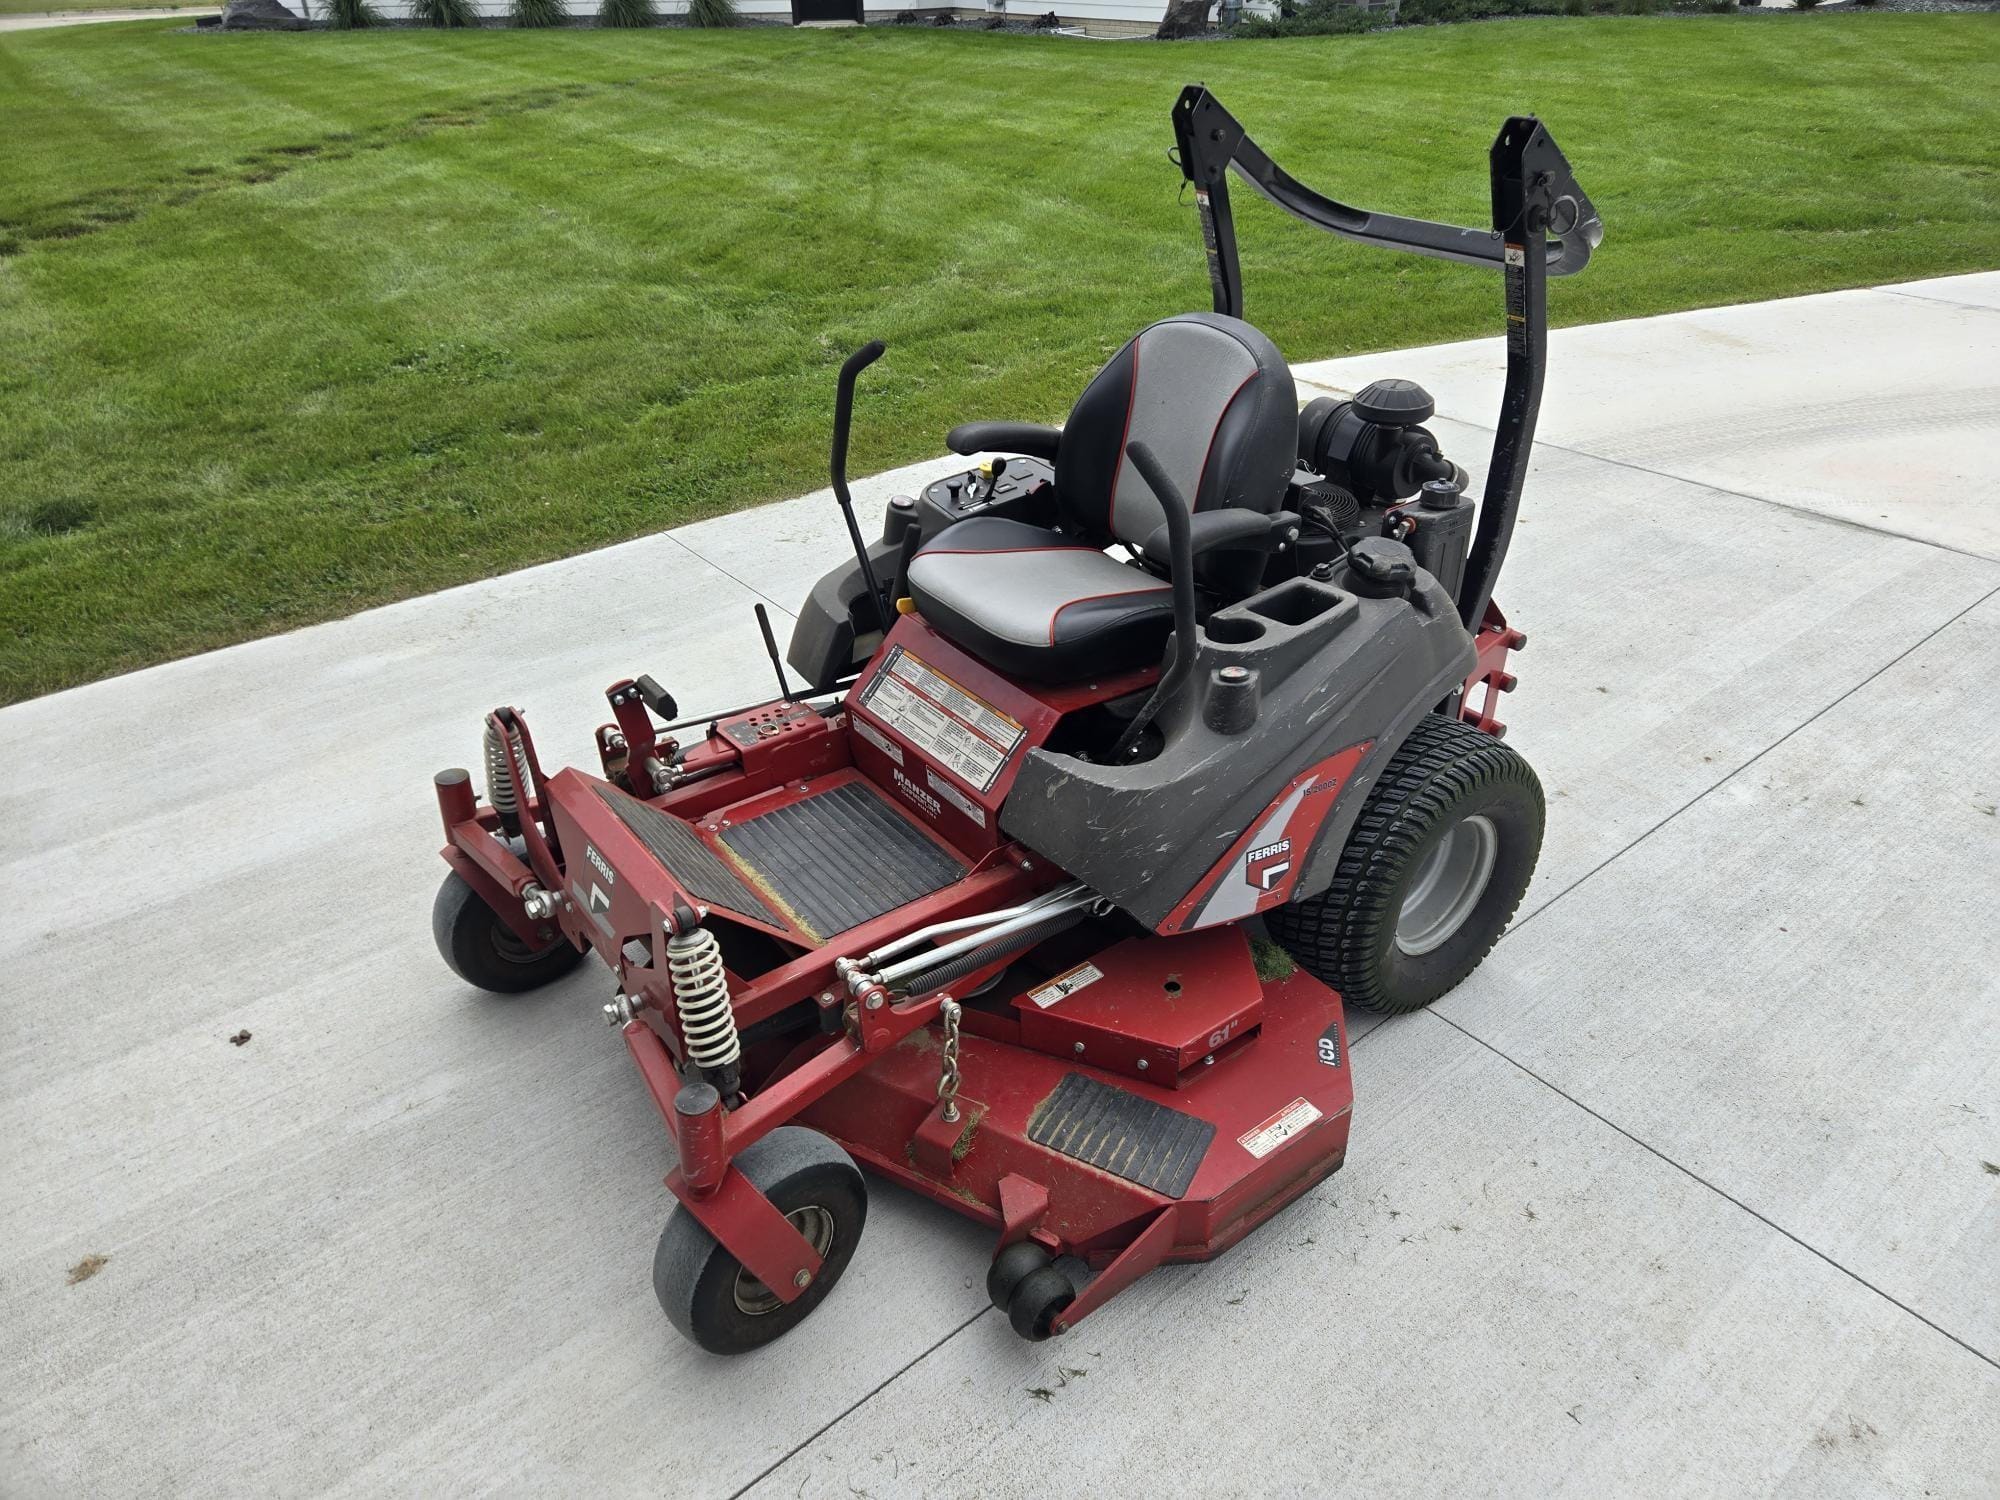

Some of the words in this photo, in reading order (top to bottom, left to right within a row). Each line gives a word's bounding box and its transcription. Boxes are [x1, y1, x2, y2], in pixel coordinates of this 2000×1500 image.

[893, 768, 942, 815] MANZER
[586, 845, 615, 885] FERRIS
[1247, 840, 1290, 863] FERRIS
[1318, 1038, 1336, 1066] iCD
